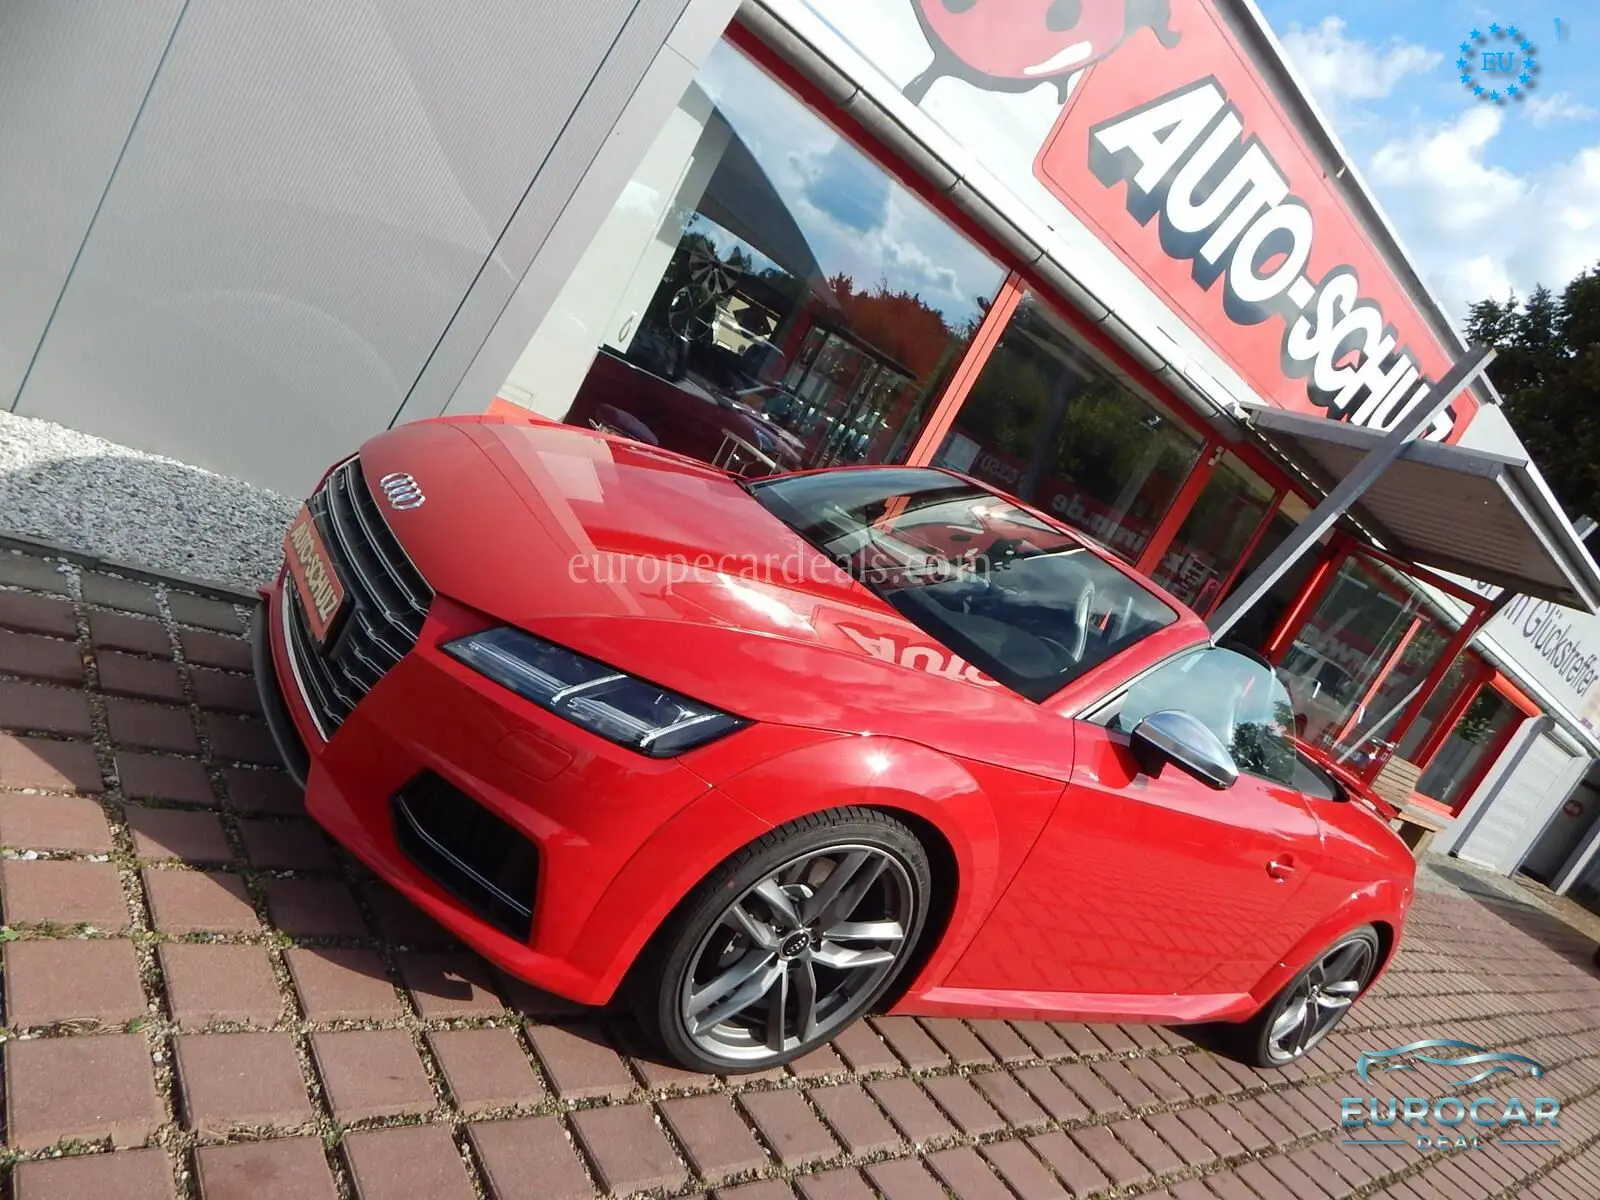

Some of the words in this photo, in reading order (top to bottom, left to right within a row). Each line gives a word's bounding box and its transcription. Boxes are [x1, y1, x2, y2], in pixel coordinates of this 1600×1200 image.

[1090, 79, 1455, 442] AUTO-SCHU
[290, 520, 338, 622] AUTO-SCHULZ
[1522, 597, 1599, 697] Glückstreffer
